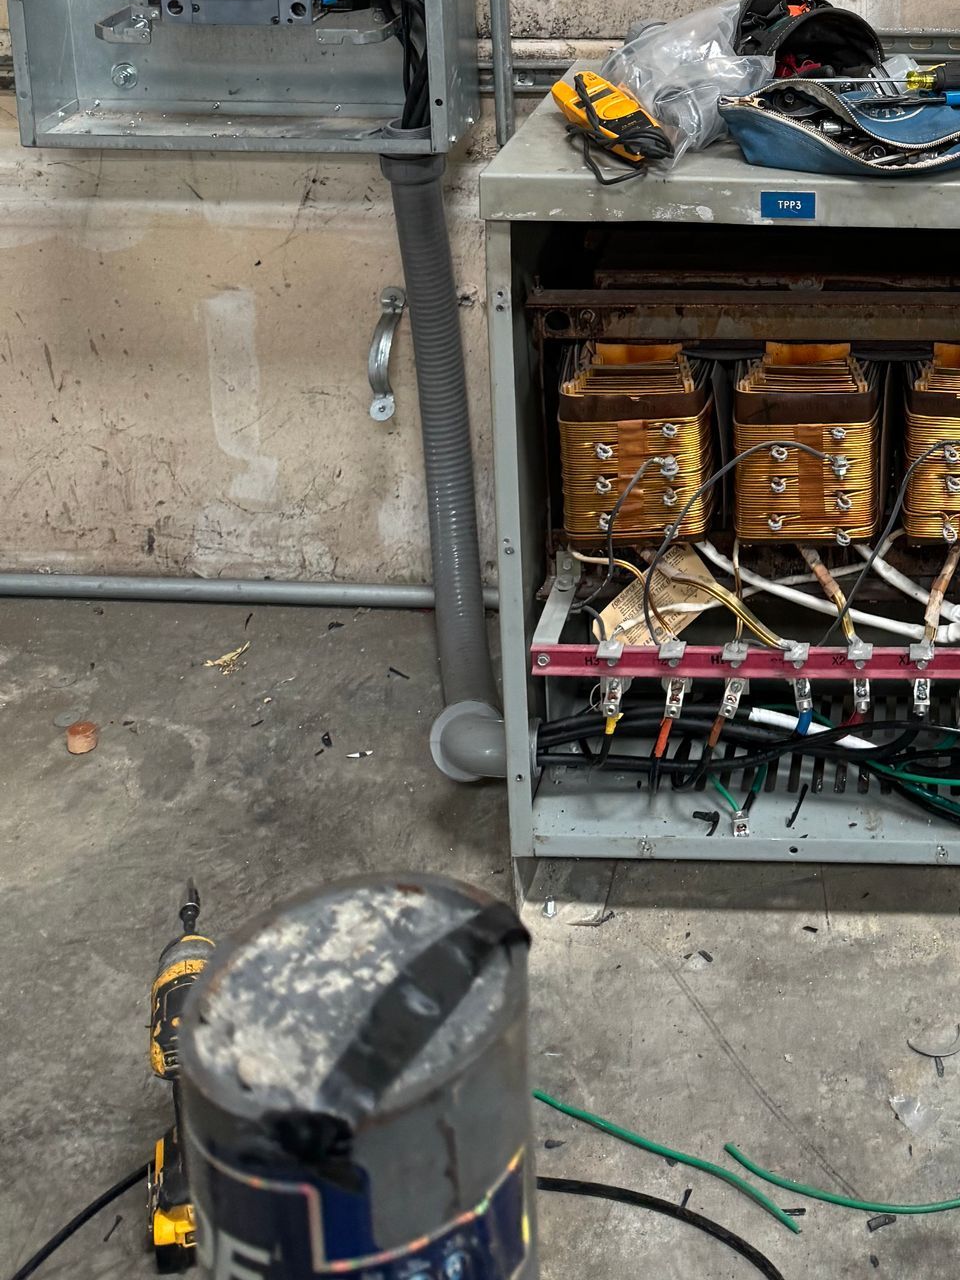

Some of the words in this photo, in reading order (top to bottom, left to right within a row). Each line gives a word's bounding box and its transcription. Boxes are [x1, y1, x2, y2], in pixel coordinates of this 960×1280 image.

[869, 106, 906, 118] KLE
[777, 200, 801, 210] TPP3
[585, 656, 600, 666] H3
[831, 656, 846, 666] X2
